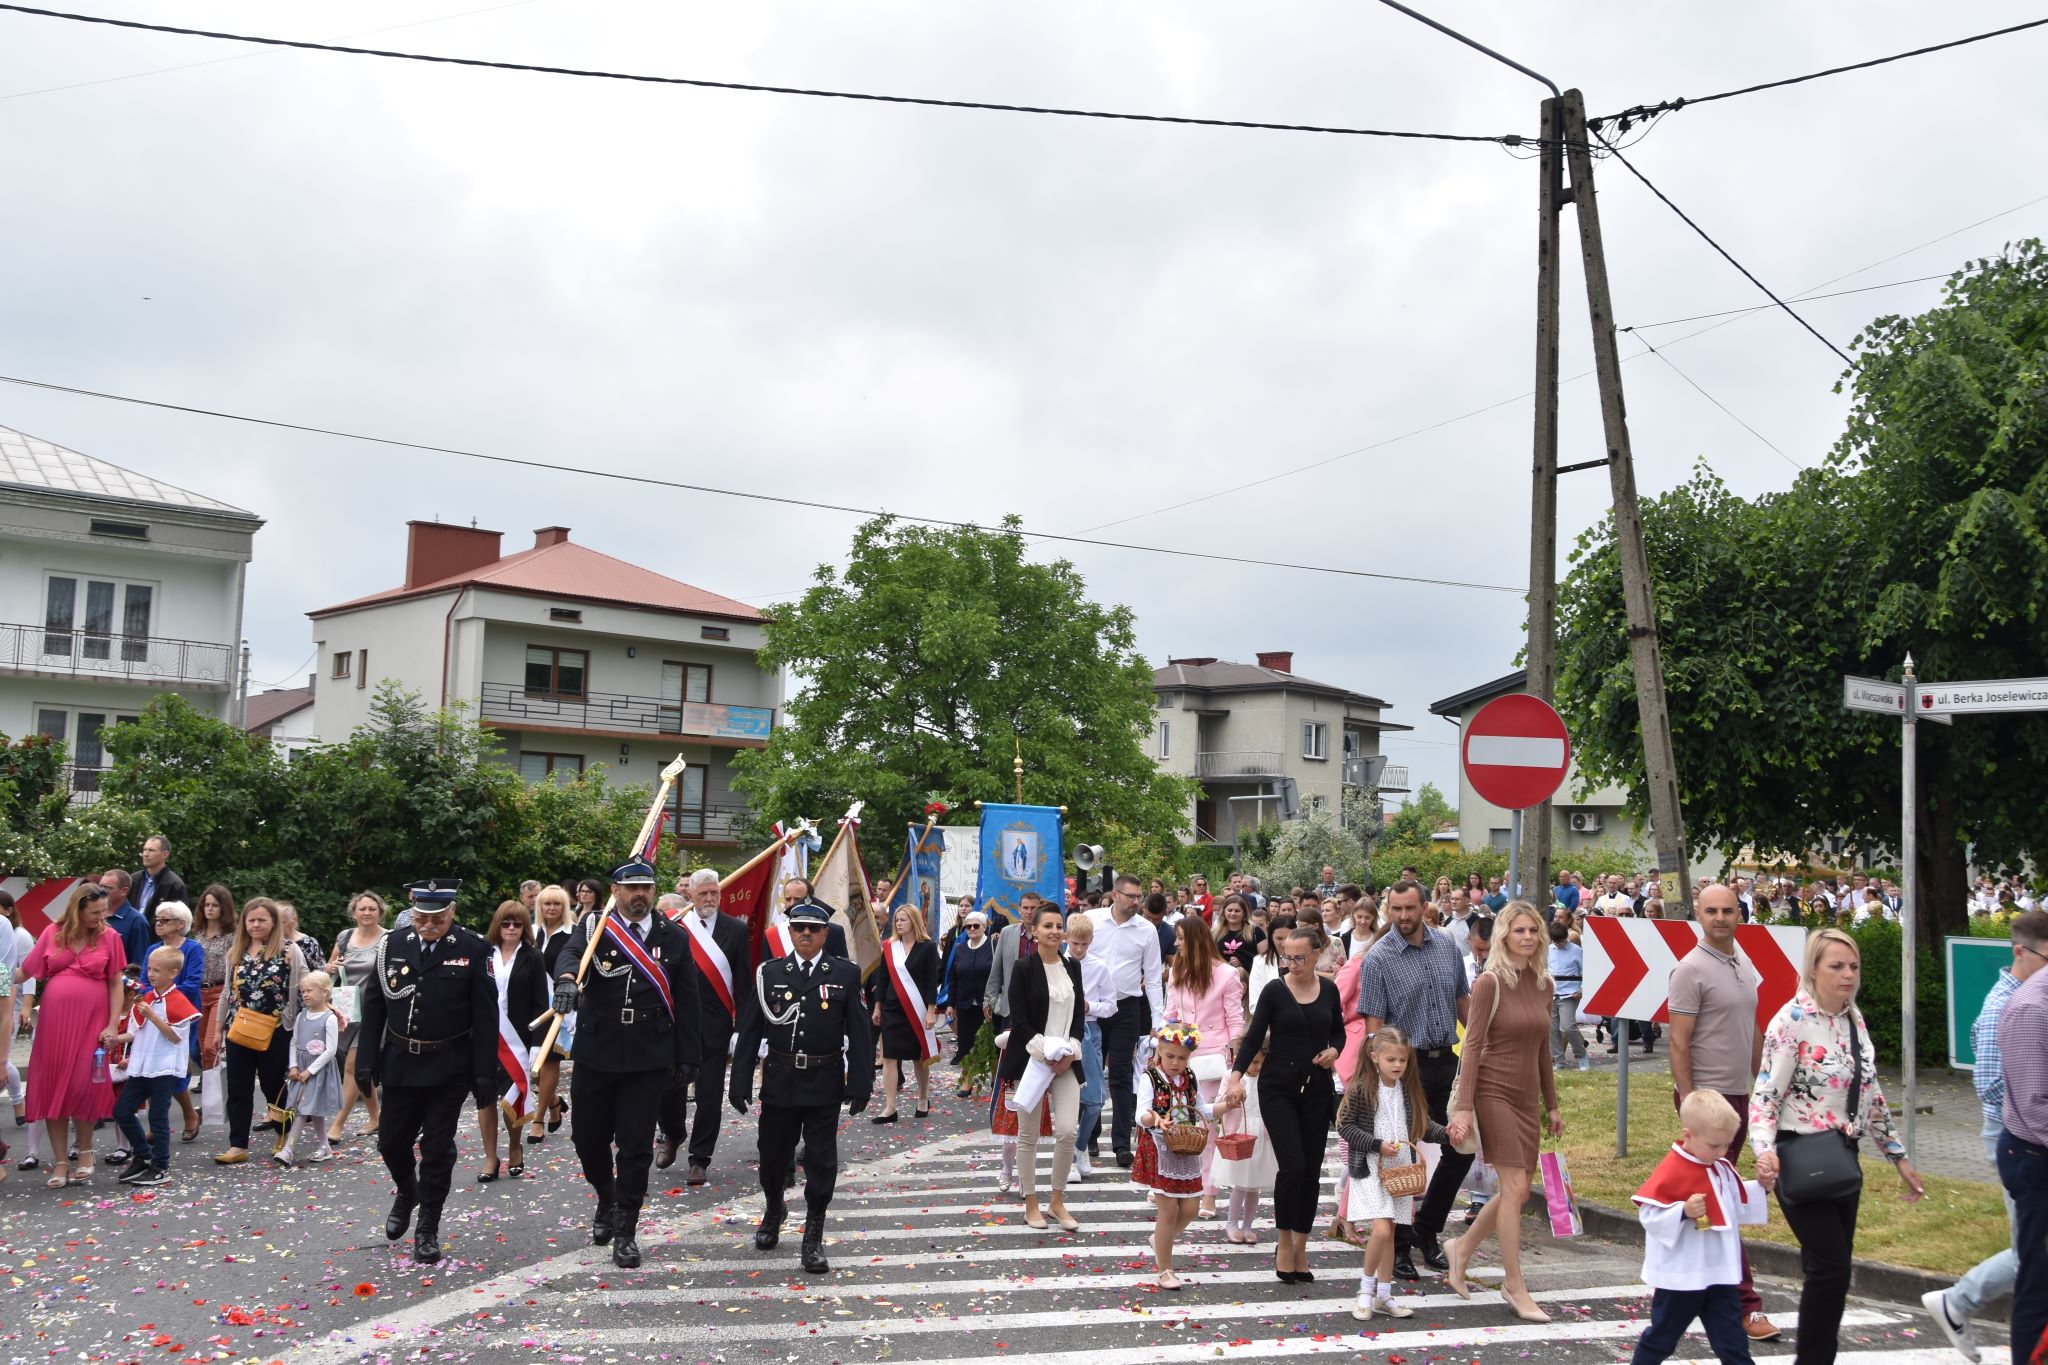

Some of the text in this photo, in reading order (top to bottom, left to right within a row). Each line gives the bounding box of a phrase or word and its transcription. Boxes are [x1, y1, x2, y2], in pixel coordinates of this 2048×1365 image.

[1862, 690, 1893, 704] Warszawska
[1938, 690, 2048, 704] ul. Berka Joselewicza
[1666, 880, 1674, 892] 3
[729, 888, 752, 904] BÓG
